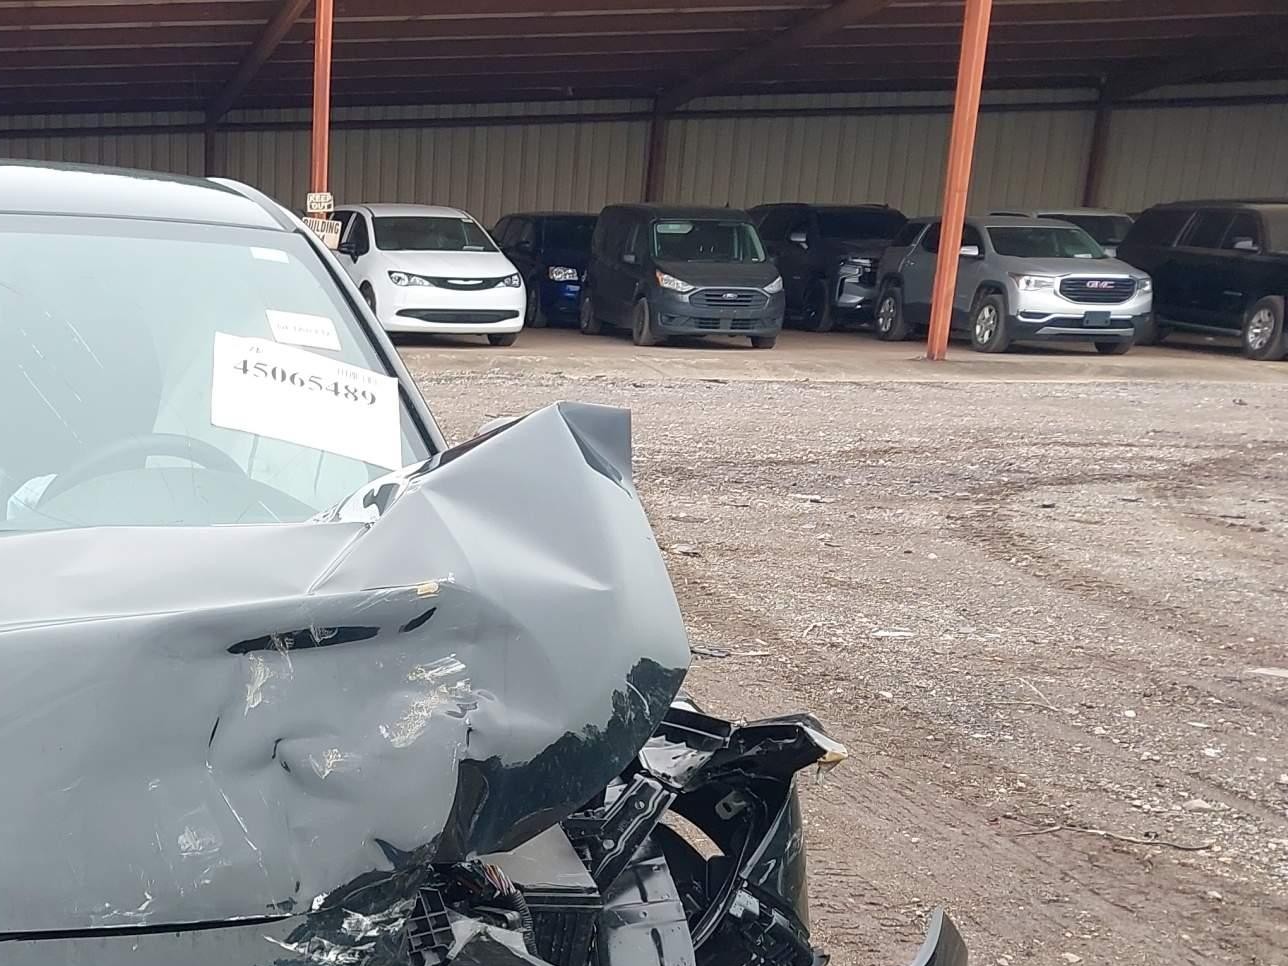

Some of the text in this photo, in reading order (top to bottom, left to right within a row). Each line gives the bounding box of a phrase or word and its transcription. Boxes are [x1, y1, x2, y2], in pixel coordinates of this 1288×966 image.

[309, 194, 332, 203] KEEP
[311, 202, 330, 210] OUT
[1086, 280, 1115, 289] GMC
[233, 360, 377, 405] 45065489
